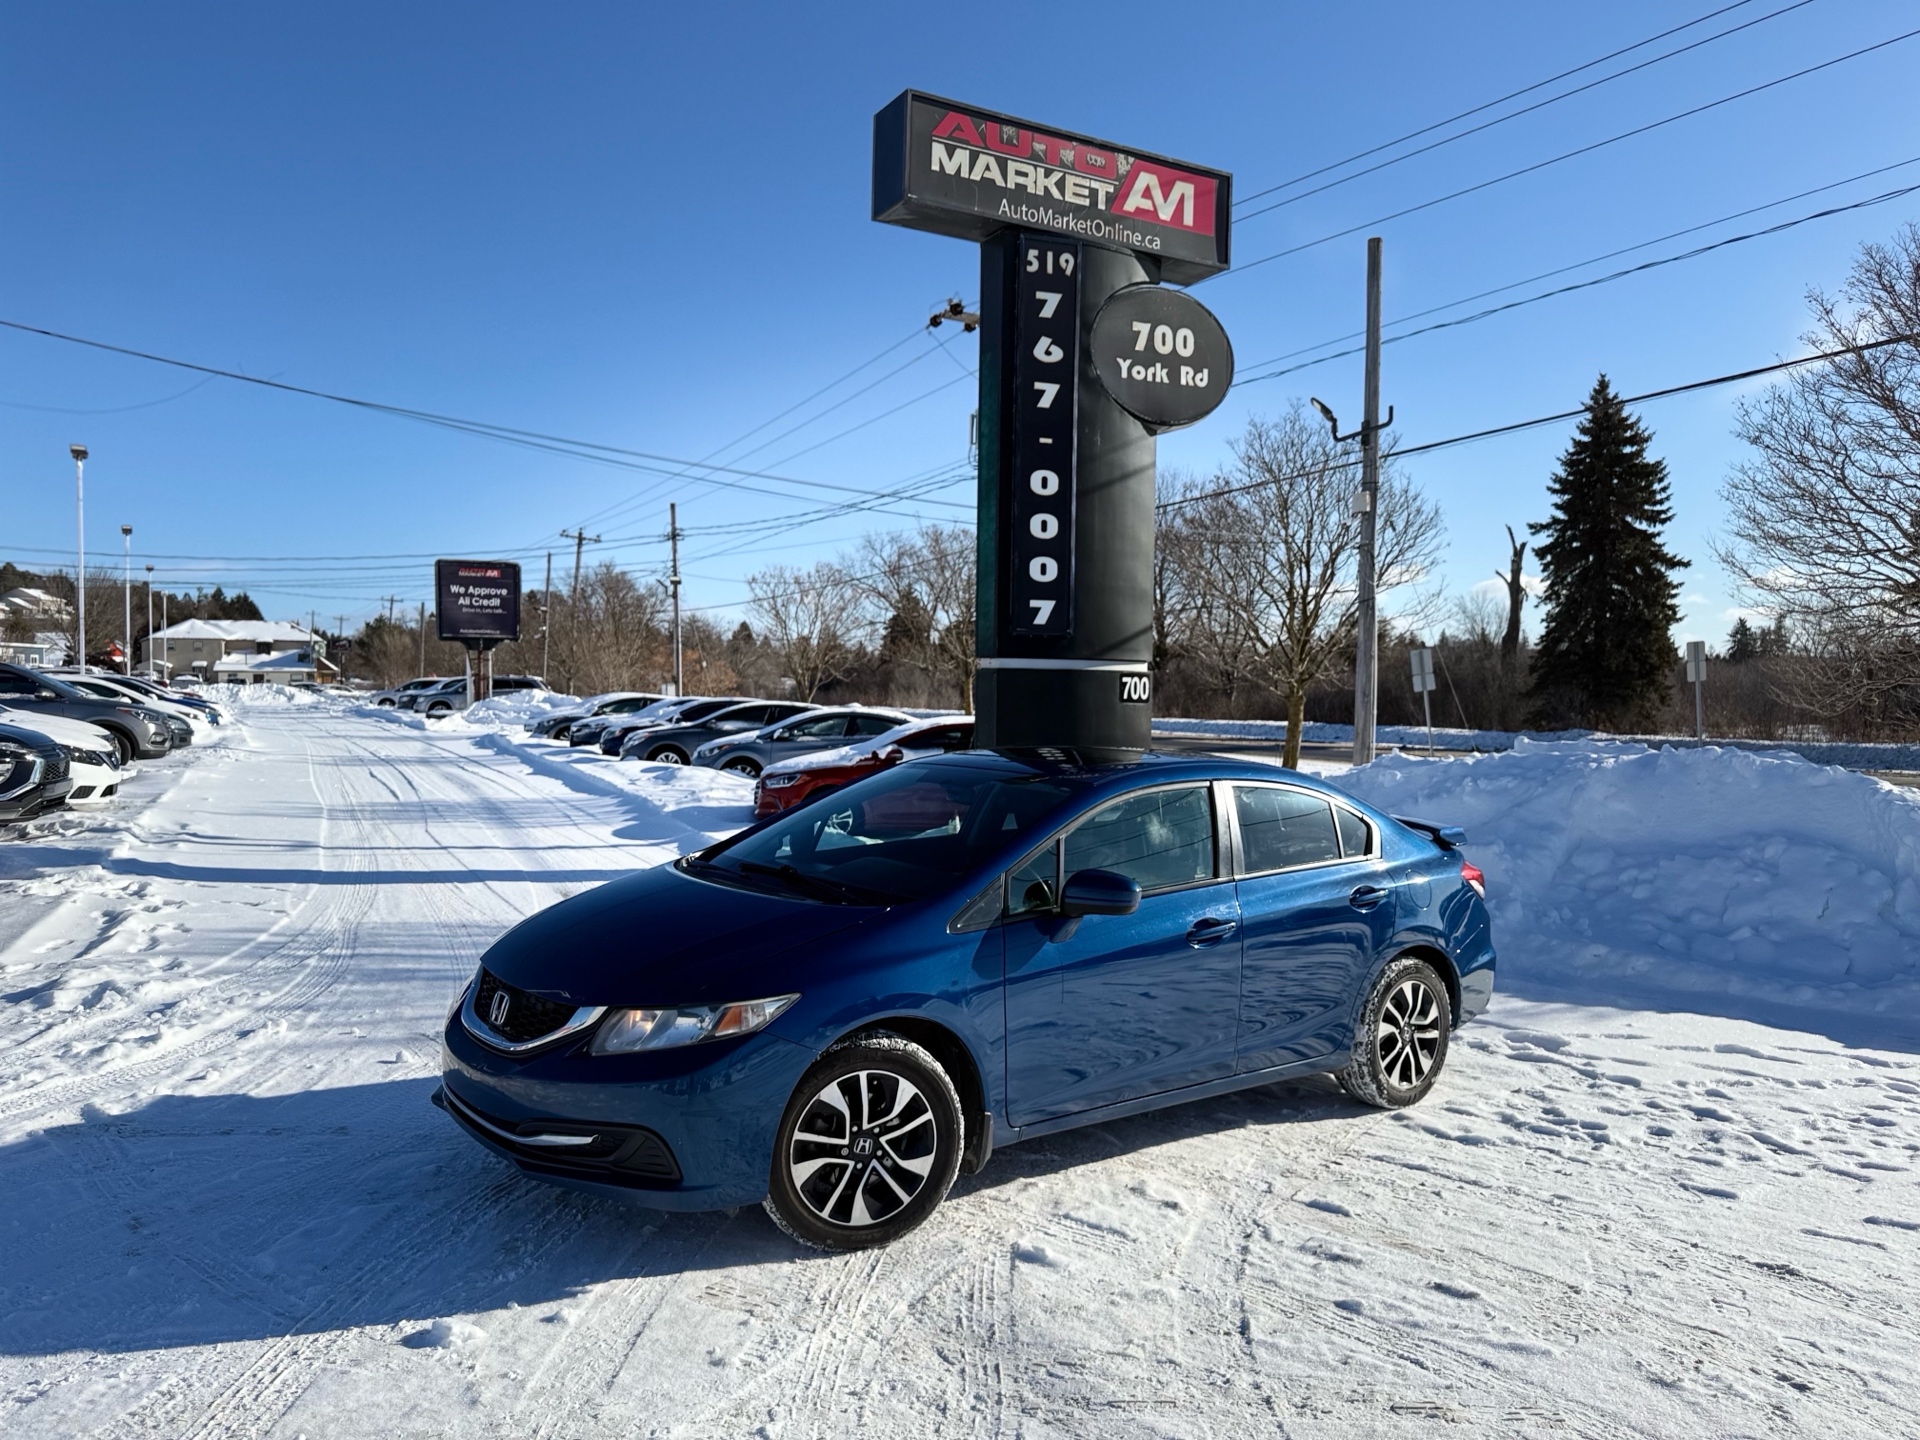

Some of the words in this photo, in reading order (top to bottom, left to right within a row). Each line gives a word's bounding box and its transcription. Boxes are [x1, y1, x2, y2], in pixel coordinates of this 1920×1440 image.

[932, 111, 1118, 180] AUTO
[930, 141, 1115, 210] MARKET
[998, 199, 1162, 251] AutoMarketOnline.ca
[1026, 249, 1075, 276] 519
[1132, 321, 1195, 357] 700
[1116, 357, 1170, 384] York
[1180, 365, 1209, 388] Rd
[450, 585, 465, 594] We
[468, 586, 508, 596] Approve
[458, 596, 470, 605] All
[472, 597, 500, 606] Credit
[1122, 676, 1149, 700] 700
